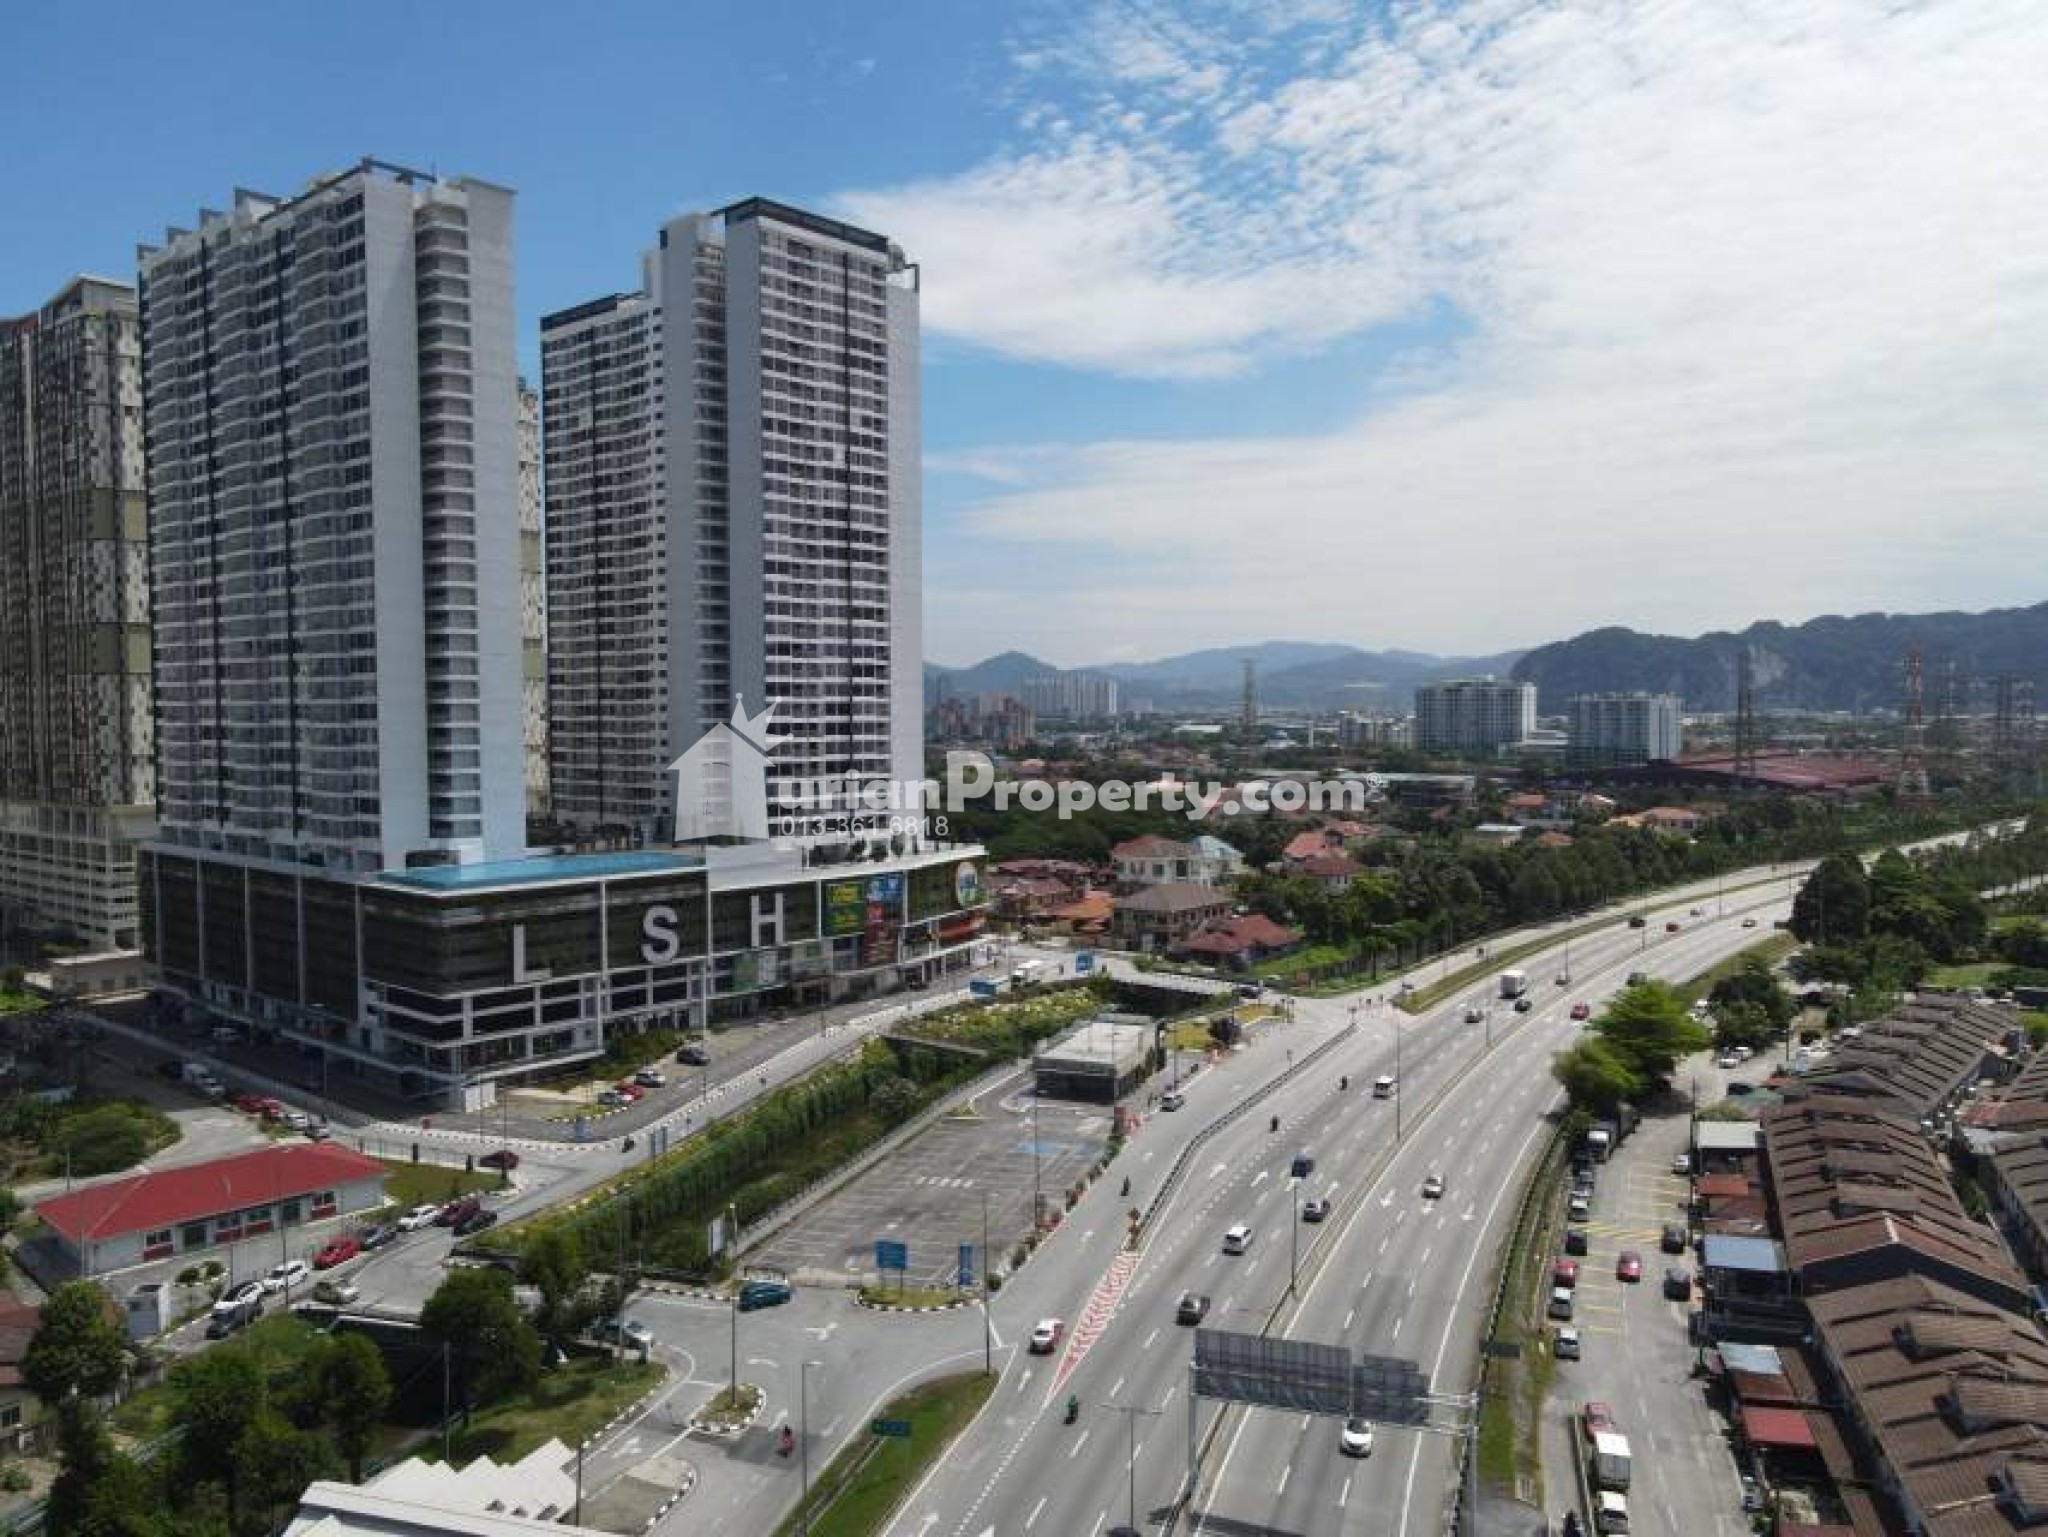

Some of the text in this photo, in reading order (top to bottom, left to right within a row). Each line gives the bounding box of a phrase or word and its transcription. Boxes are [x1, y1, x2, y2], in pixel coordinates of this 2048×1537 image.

[513, 893, 784, 983] L S H
